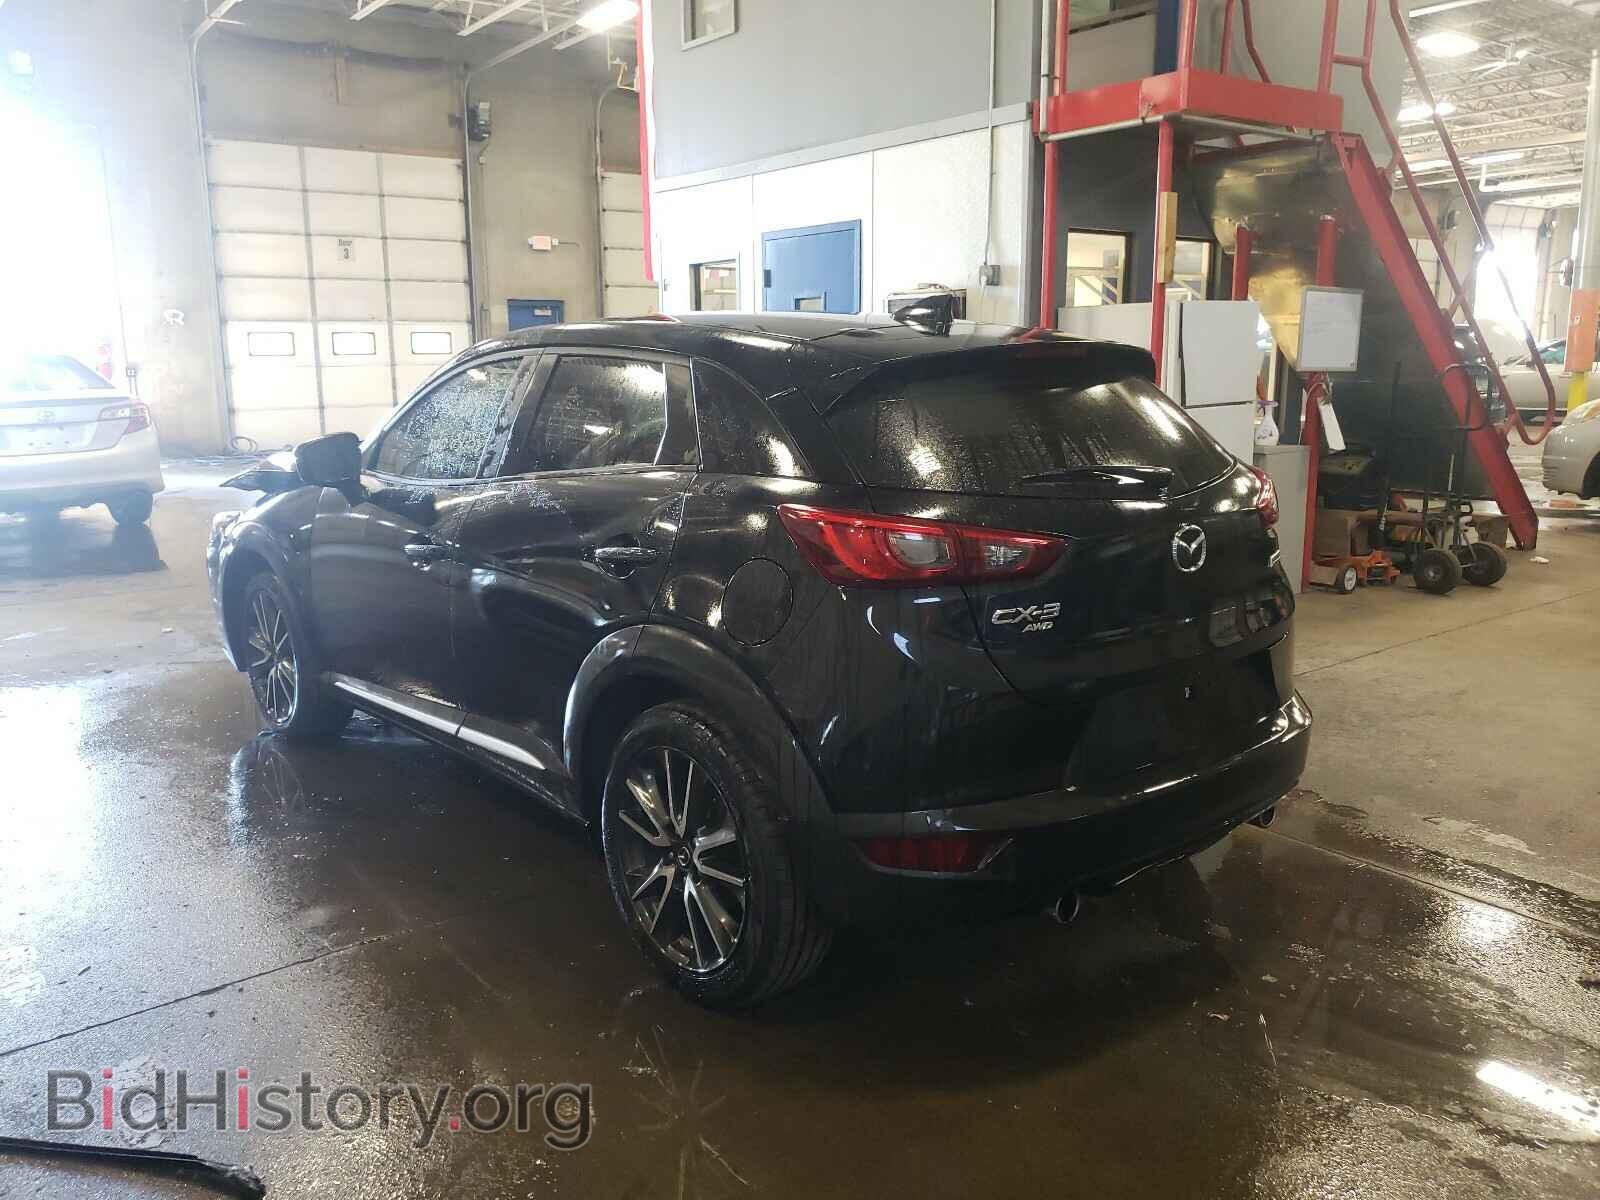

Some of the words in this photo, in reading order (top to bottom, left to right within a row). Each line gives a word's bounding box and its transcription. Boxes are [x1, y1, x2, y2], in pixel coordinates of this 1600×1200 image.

[343, 247, 350, 260] 3
[991, 602, 1061, 625] CX-3
[1021, 621, 1055, 633] AWD
